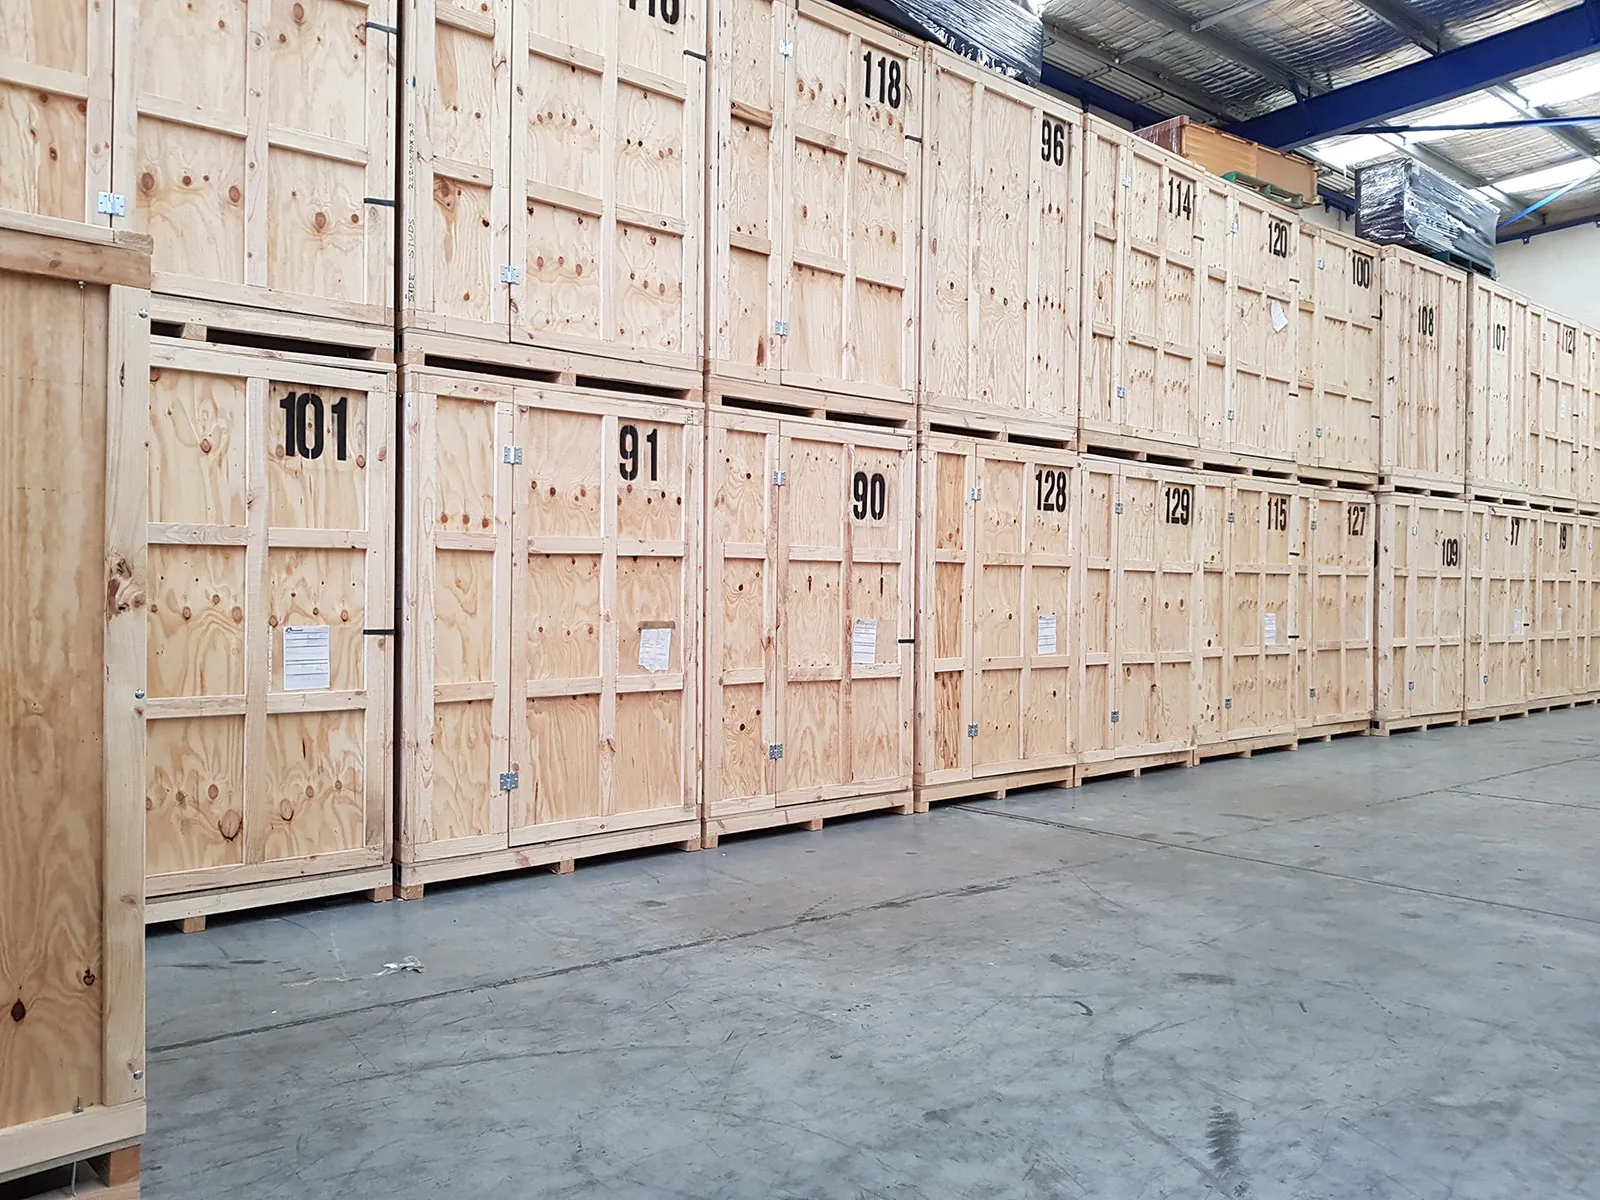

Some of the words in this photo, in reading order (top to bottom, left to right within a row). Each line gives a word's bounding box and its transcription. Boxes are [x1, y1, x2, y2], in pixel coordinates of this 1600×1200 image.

[863, 50, 901, 110] 118
[1041, 118, 1065, 167] 96
[1168, 176, 1192, 221] 114
[1268, 220, 1288, 259] 120
[1352, 254, 1370, 289] 100
[1418, 305, 1434, 337] 108
[1492, 322, 1506, 352] 107
[1561, 328, 1573, 355] 112
[279, 390, 348, 462] 101
[619, 424, 658, 482] 91
[852, 471, 886, 521] 90
[1035, 469, 1067, 513] 128
[1164, 487, 1190, 526] 129
[1267, 497, 1287, 532] 115
[1347, 505, 1367, 537] 127
[1441, 538, 1459, 567] 109
